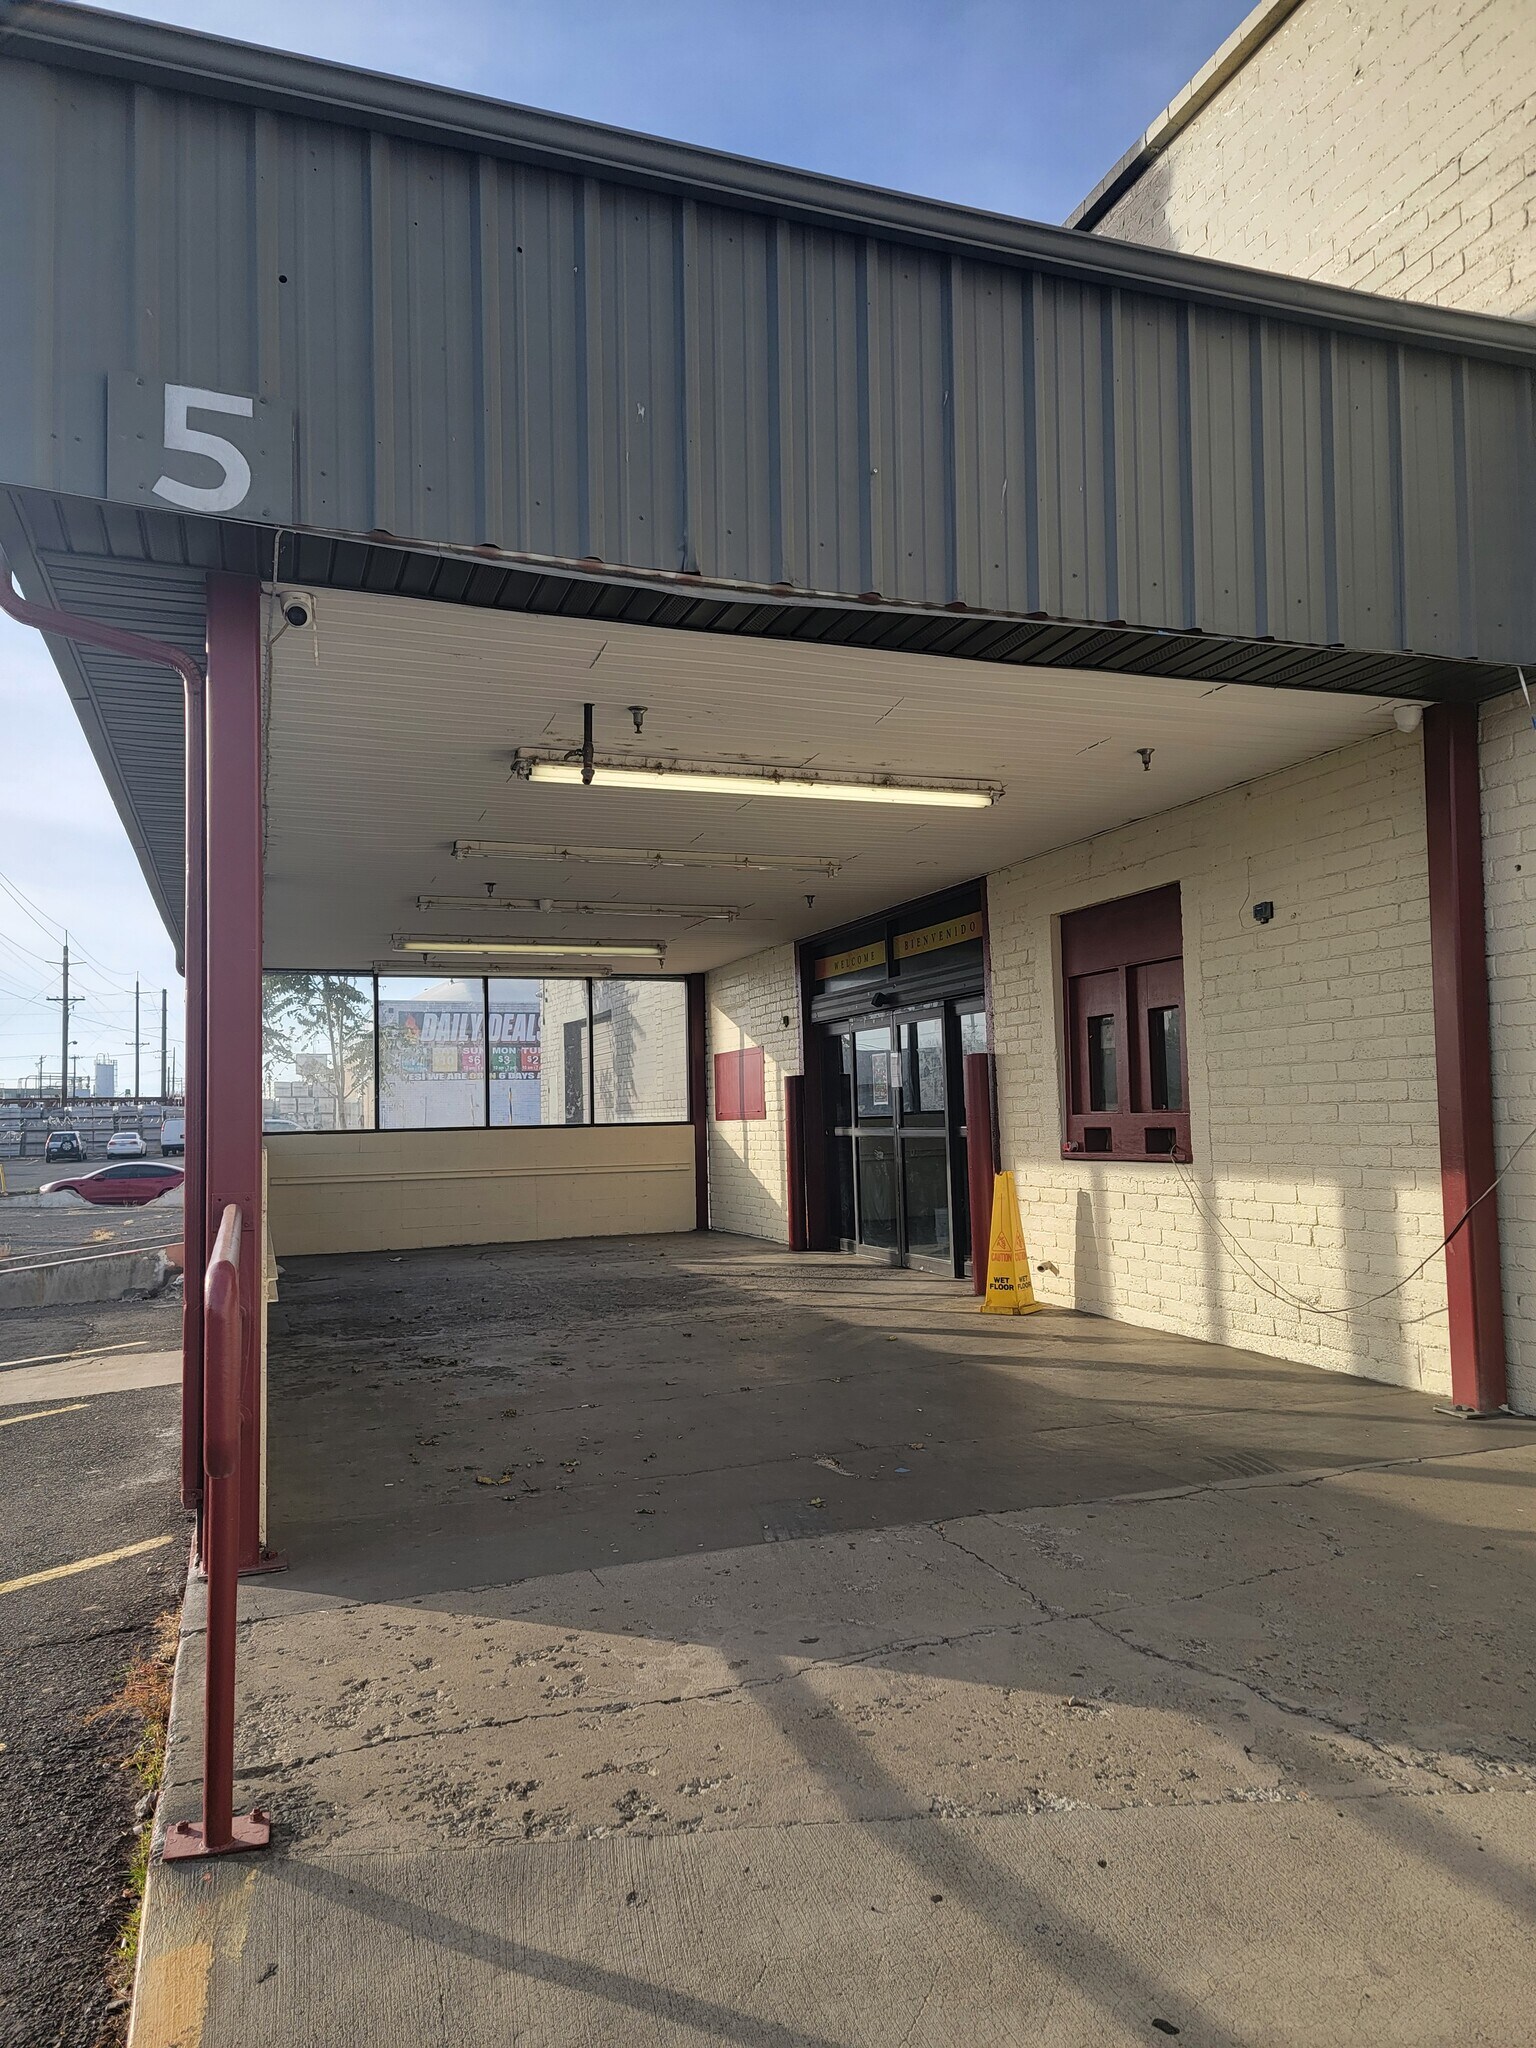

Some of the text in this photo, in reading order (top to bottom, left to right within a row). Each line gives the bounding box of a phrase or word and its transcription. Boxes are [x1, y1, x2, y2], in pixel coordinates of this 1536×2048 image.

[152, 383, 253, 512] 5
[904, 921, 976, 951] BIENVENIDO
[834, 951, 876, 971] WELCOME
[421, 1013, 484, 1042] DAILY
[468, 1055, 481, 1065] $6
[498, 1056, 511, 1065] $3
[527, 1055, 539, 1065] $2
[989, 1283, 1015, 1291] FLOOR
